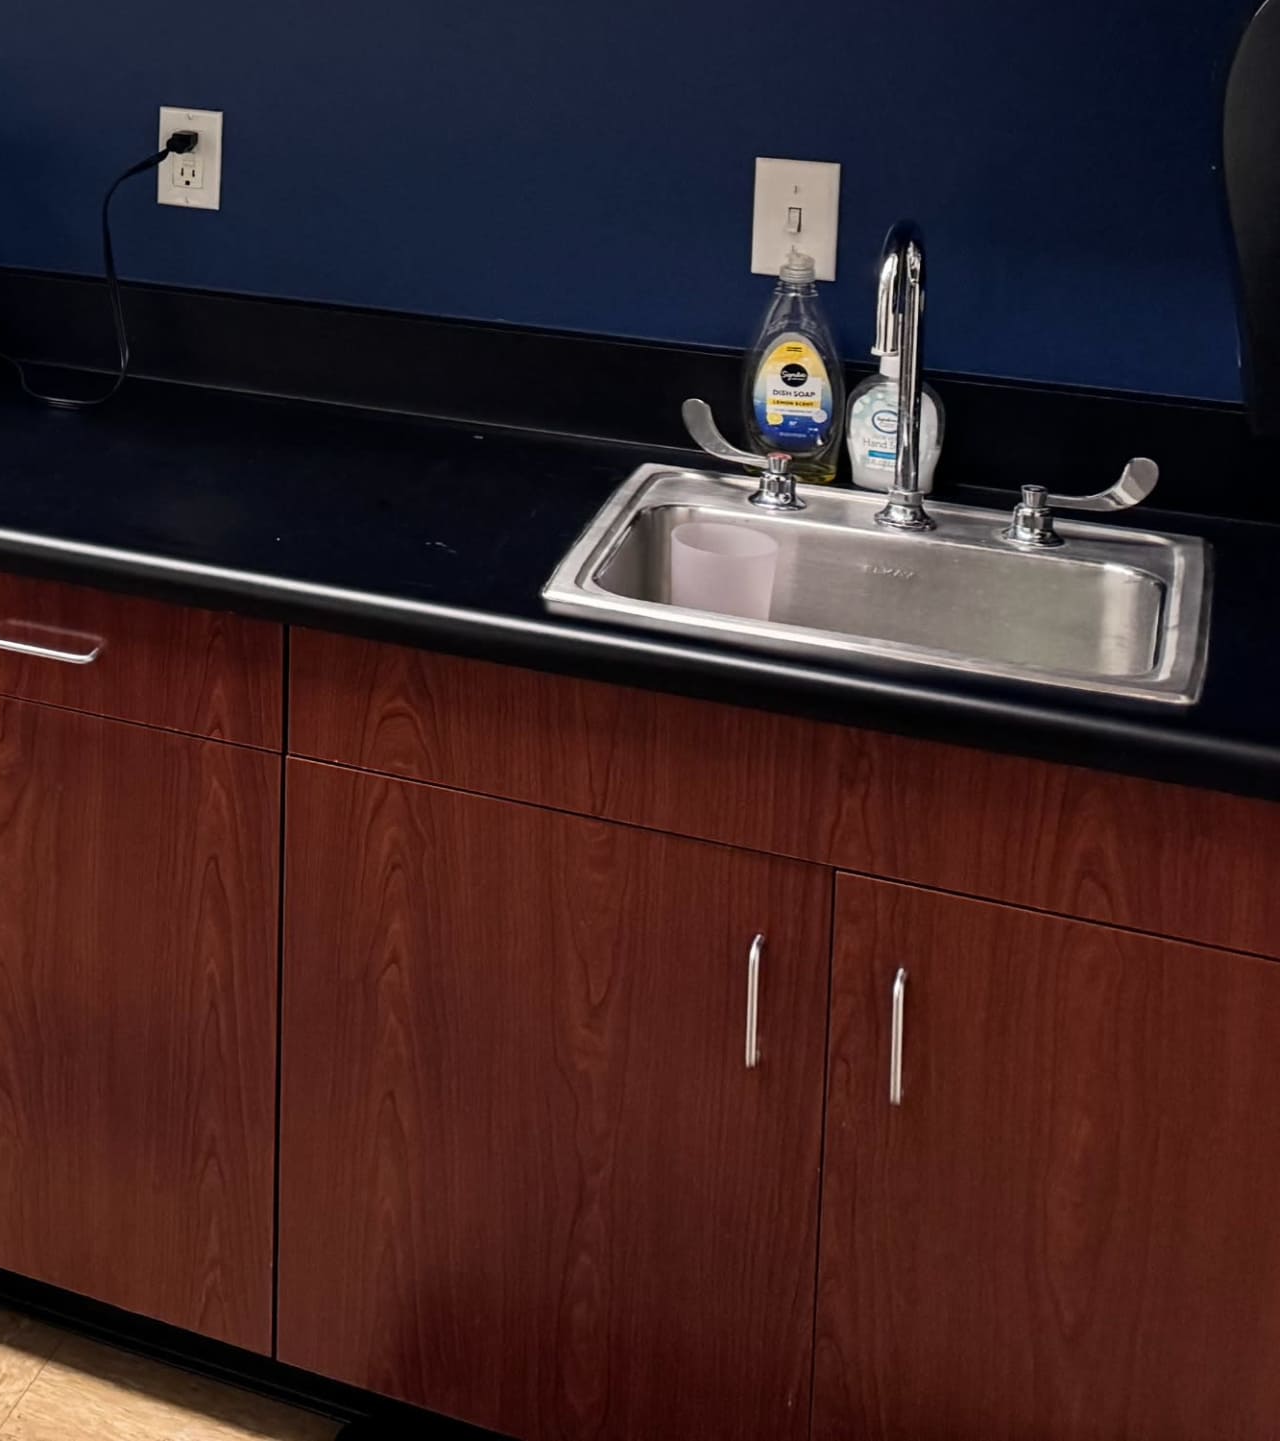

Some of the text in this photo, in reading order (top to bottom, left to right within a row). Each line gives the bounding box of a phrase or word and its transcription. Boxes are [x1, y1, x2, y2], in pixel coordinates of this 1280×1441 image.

[772, 389, 816, 398] DISH SOAP
[863, 437, 887, 449] Hand
